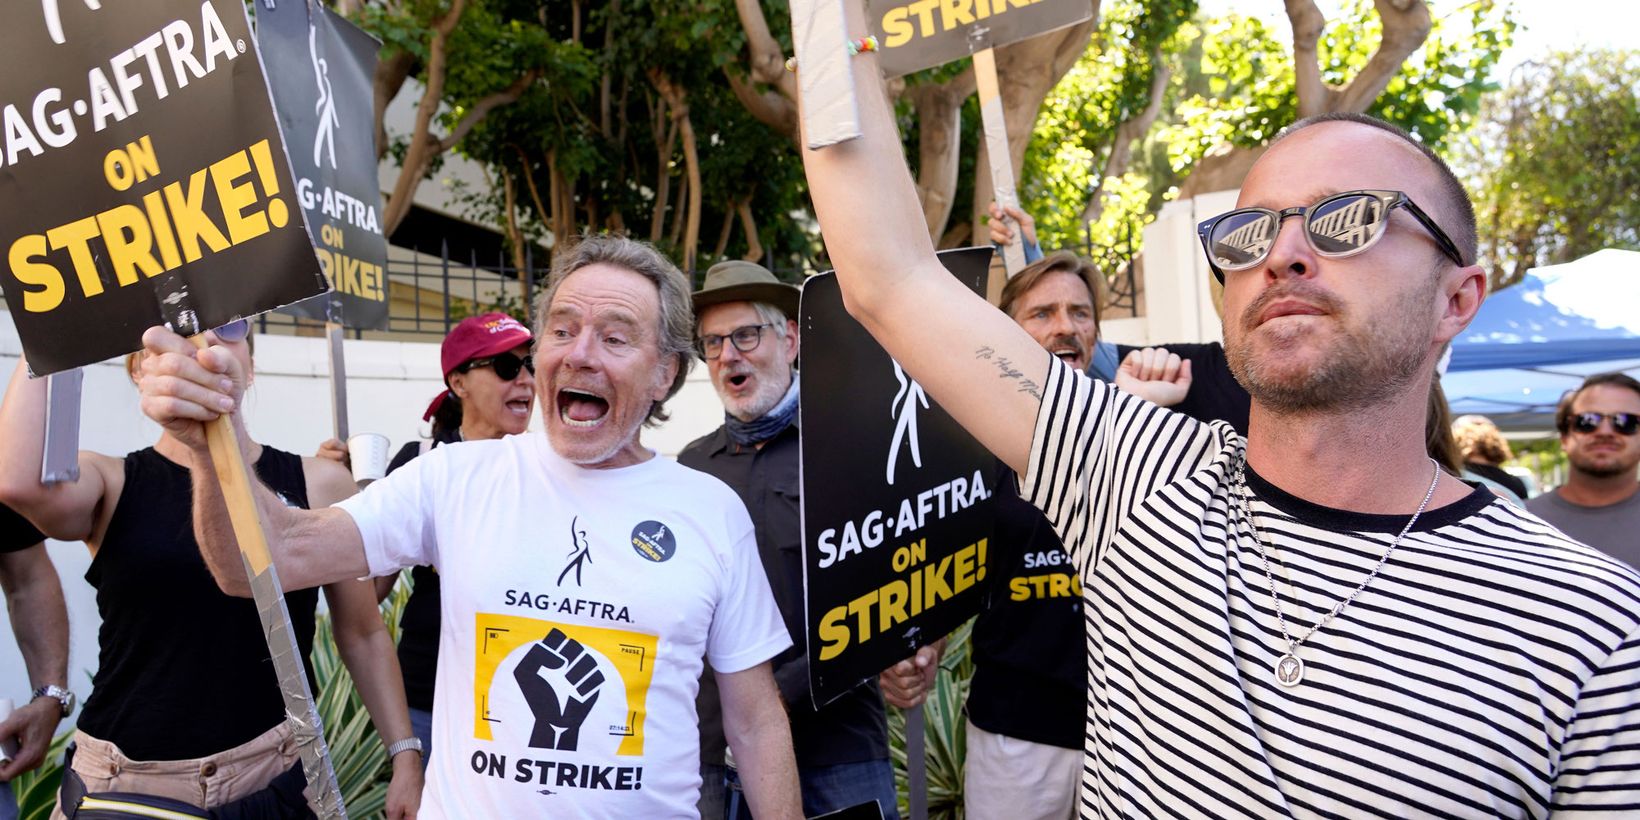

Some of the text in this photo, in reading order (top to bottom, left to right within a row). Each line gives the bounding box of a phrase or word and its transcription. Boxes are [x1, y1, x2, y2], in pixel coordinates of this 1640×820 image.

[882, 0, 1041, 48] STRI
[103, 134, 161, 191] ON
[8, 138, 289, 313] STRIKE!
[321, 224, 344, 249] ON
[315, 247, 385, 302] RIKE!
[892, 538, 927, 573] ON
[818, 538, 988, 661] STRIKE!
[471, 750, 643, 791] ON STRIKE!
